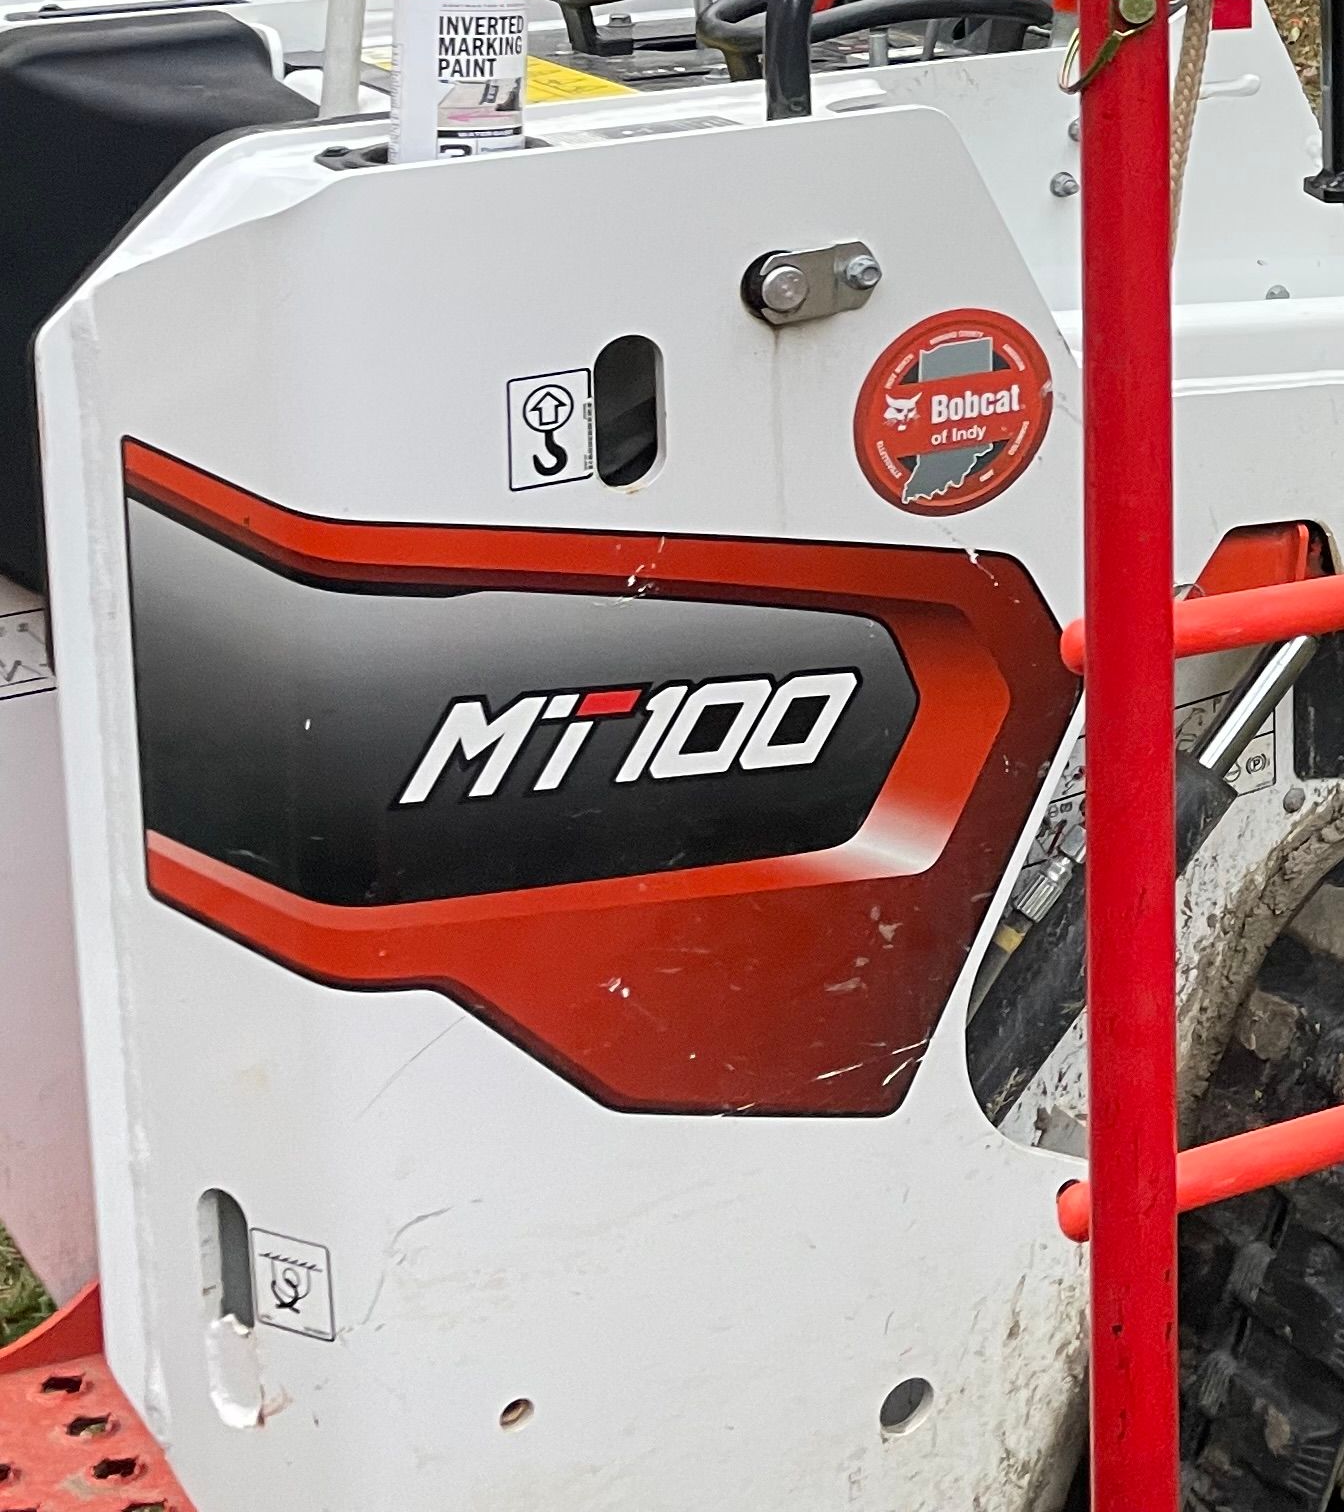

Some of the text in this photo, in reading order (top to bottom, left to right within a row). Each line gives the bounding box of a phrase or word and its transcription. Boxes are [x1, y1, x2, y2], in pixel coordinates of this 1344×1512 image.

[439, 15, 524, 35] INVERTED
[438, 36, 522, 56] MARKING
[438, 58, 497, 77] PAINT
[931, 384, 1020, 424] Bobcat
[931, 425, 987, 445] of Indy
[399, 672, 858, 804] MT100
